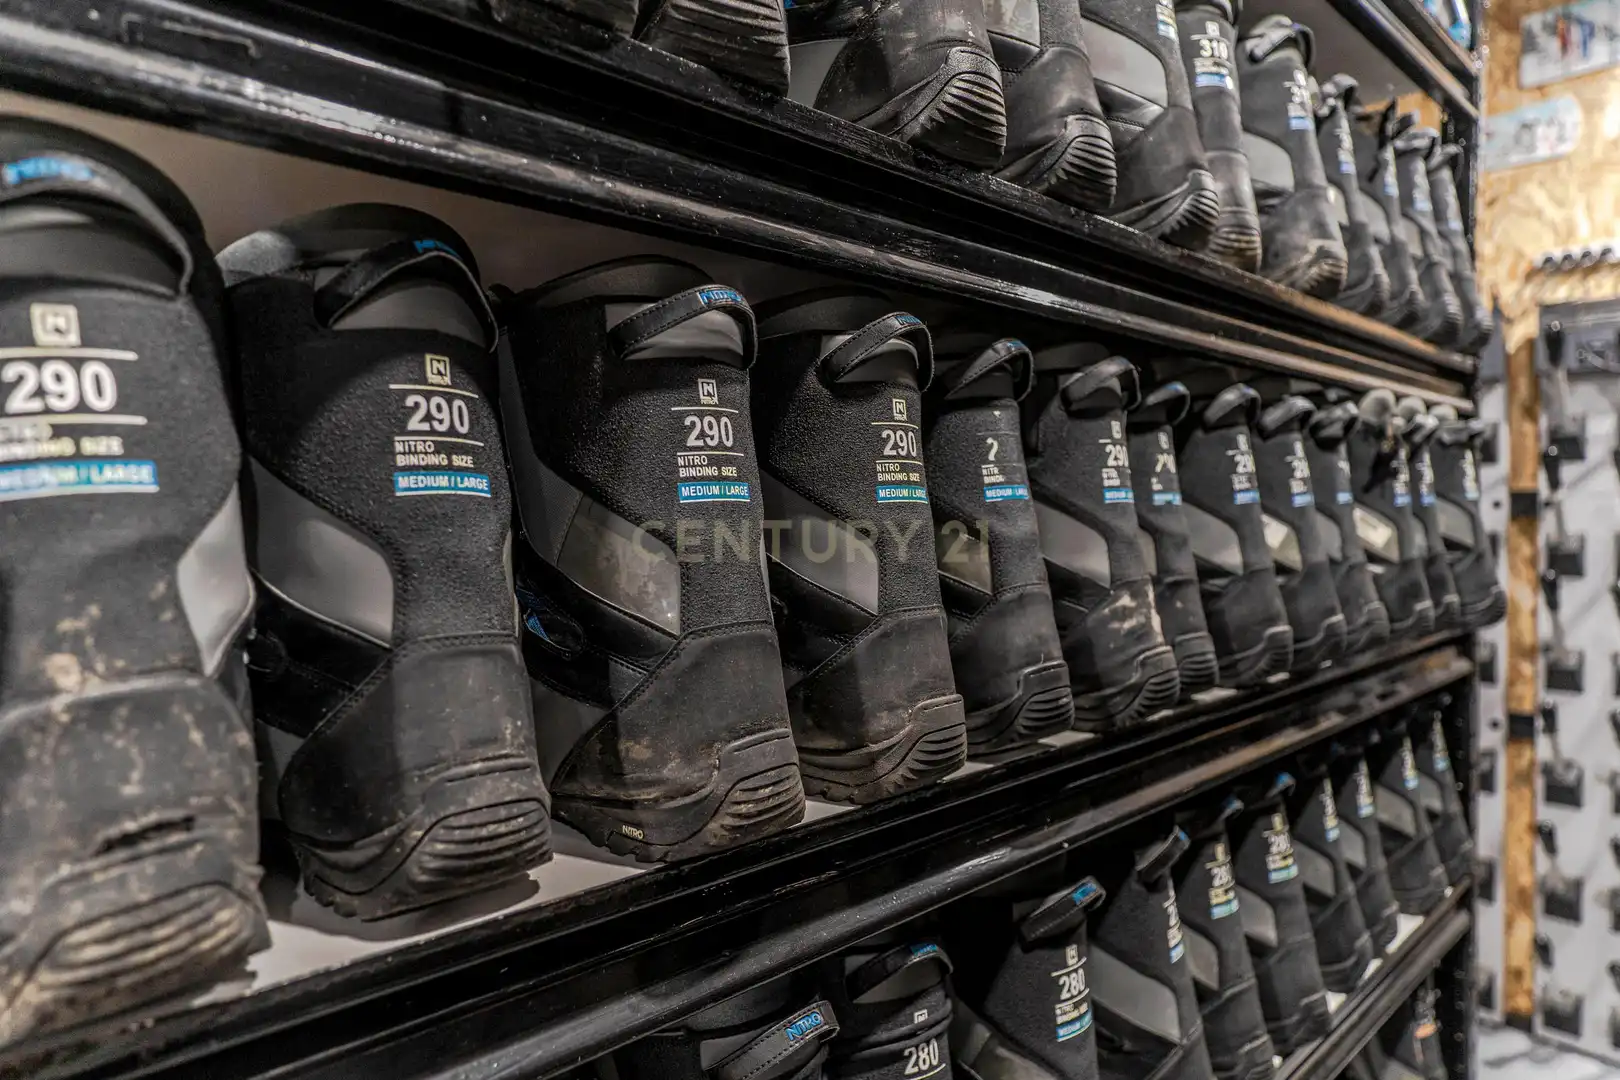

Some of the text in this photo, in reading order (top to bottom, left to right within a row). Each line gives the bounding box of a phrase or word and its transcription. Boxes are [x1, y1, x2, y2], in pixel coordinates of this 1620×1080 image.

[1199, 39, 1228, 60] 310
[0, 360, 117, 414] 290
[405, 395, 470, 434] 290
[684, 415, 734, 447] 290
[395, 441, 435, 453] NITRO
[881, 429, 917, 457] 290
[396, 453, 474, 467] BINDING SIZE
[677, 456, 708, 466] NITRO
[876, 463, 900, 472] NITRO
[680, 466, 738, 477] BINDING SIZE
[877, 472, 920, 482] BINDING SIZE
[398, 475, 450, 488] MEDIUM
[457, 476, 489, 490] LARGE
[681, 485, 720, 497] MEDIUM
[726, 486, 749, 496] LARGE
[879, 488, 909, 498] MEDIUM
[622, 824, 645, 840] NITRO
[1059, 968, 1086, 1000] 280
[785, 1011, 822, 1040] NITRO
[903, 1038, 939, 1075] 280
